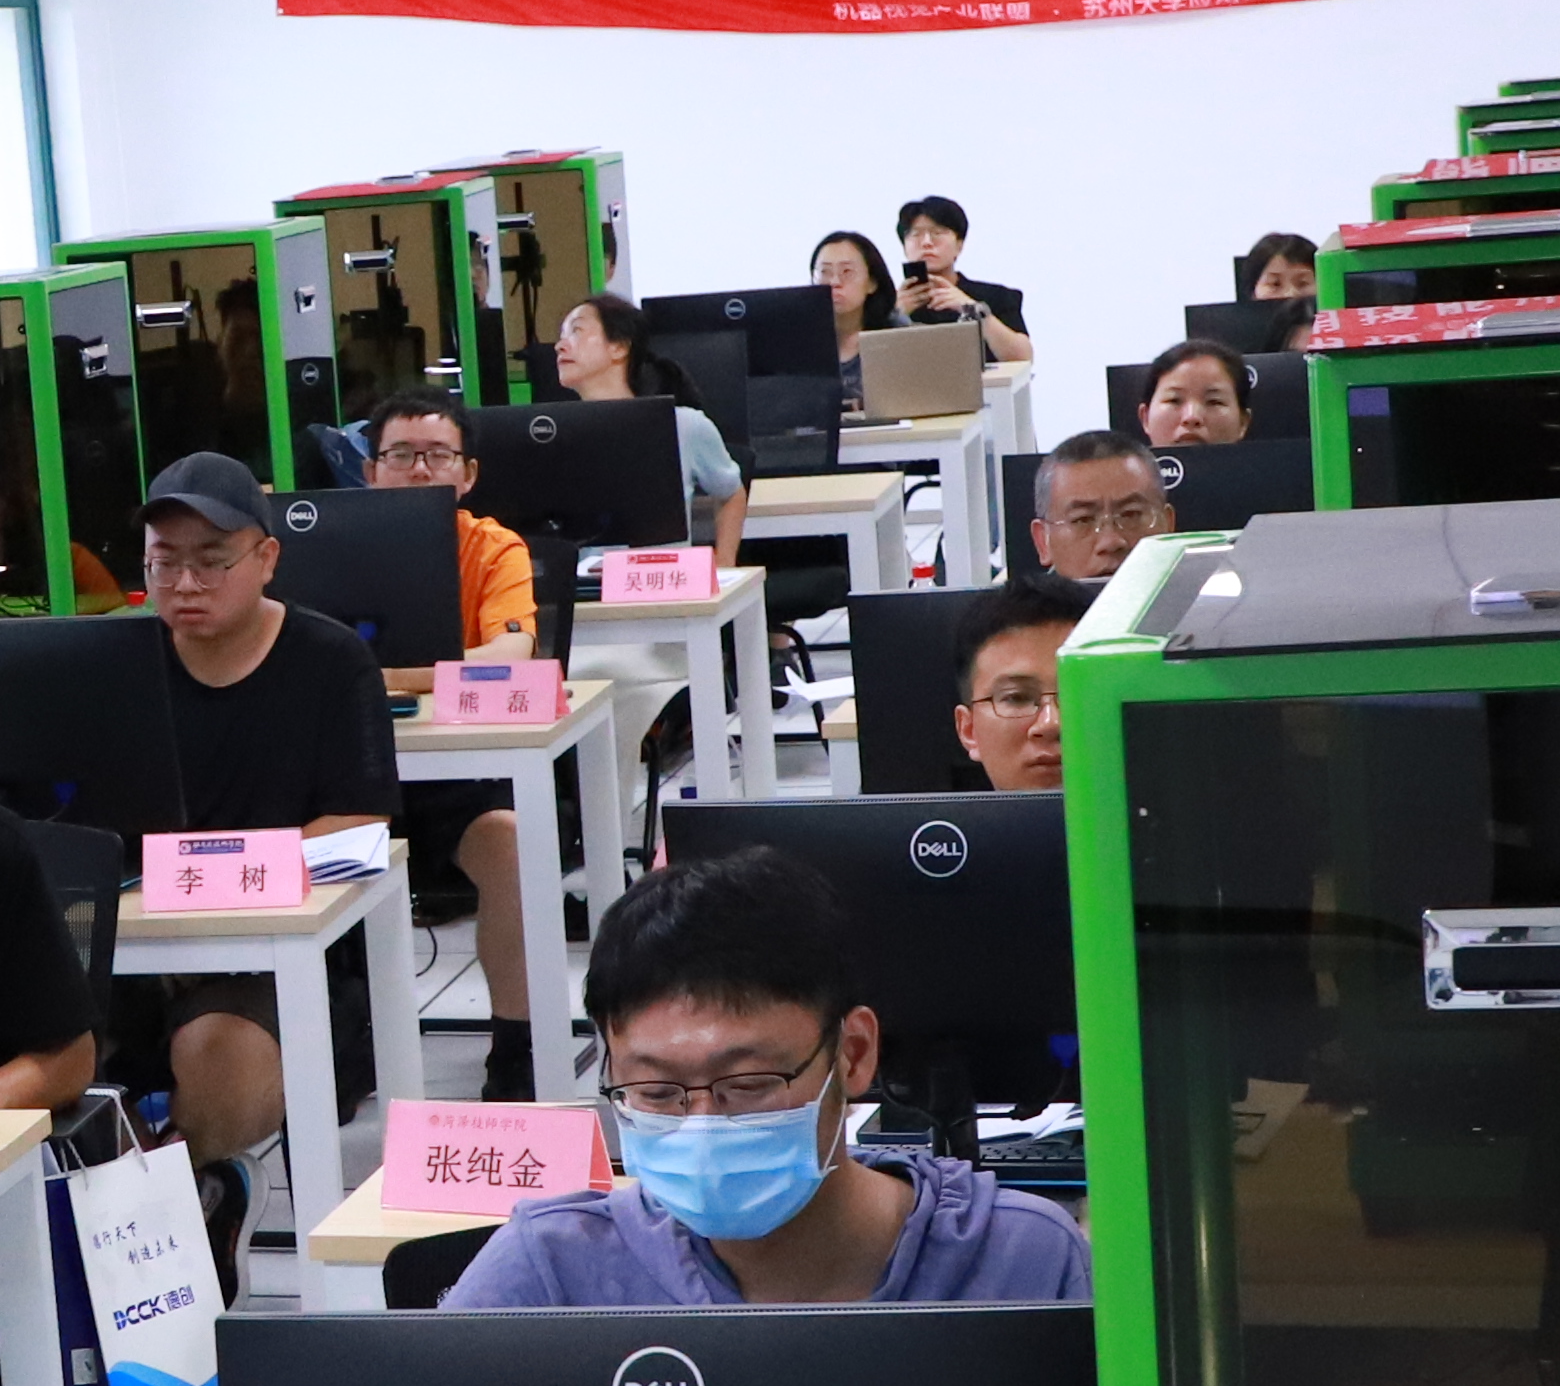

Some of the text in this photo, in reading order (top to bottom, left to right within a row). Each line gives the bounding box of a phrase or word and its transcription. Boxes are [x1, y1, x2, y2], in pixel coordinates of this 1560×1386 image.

[290, 510, 315, 521] DELL
[624, 569, 688, 593] 吴明华
[918, 841, 962, 857] DELL
[175, 863, 269, 896] 李 树
[426, 1143, 548, 1189] 张纯金
